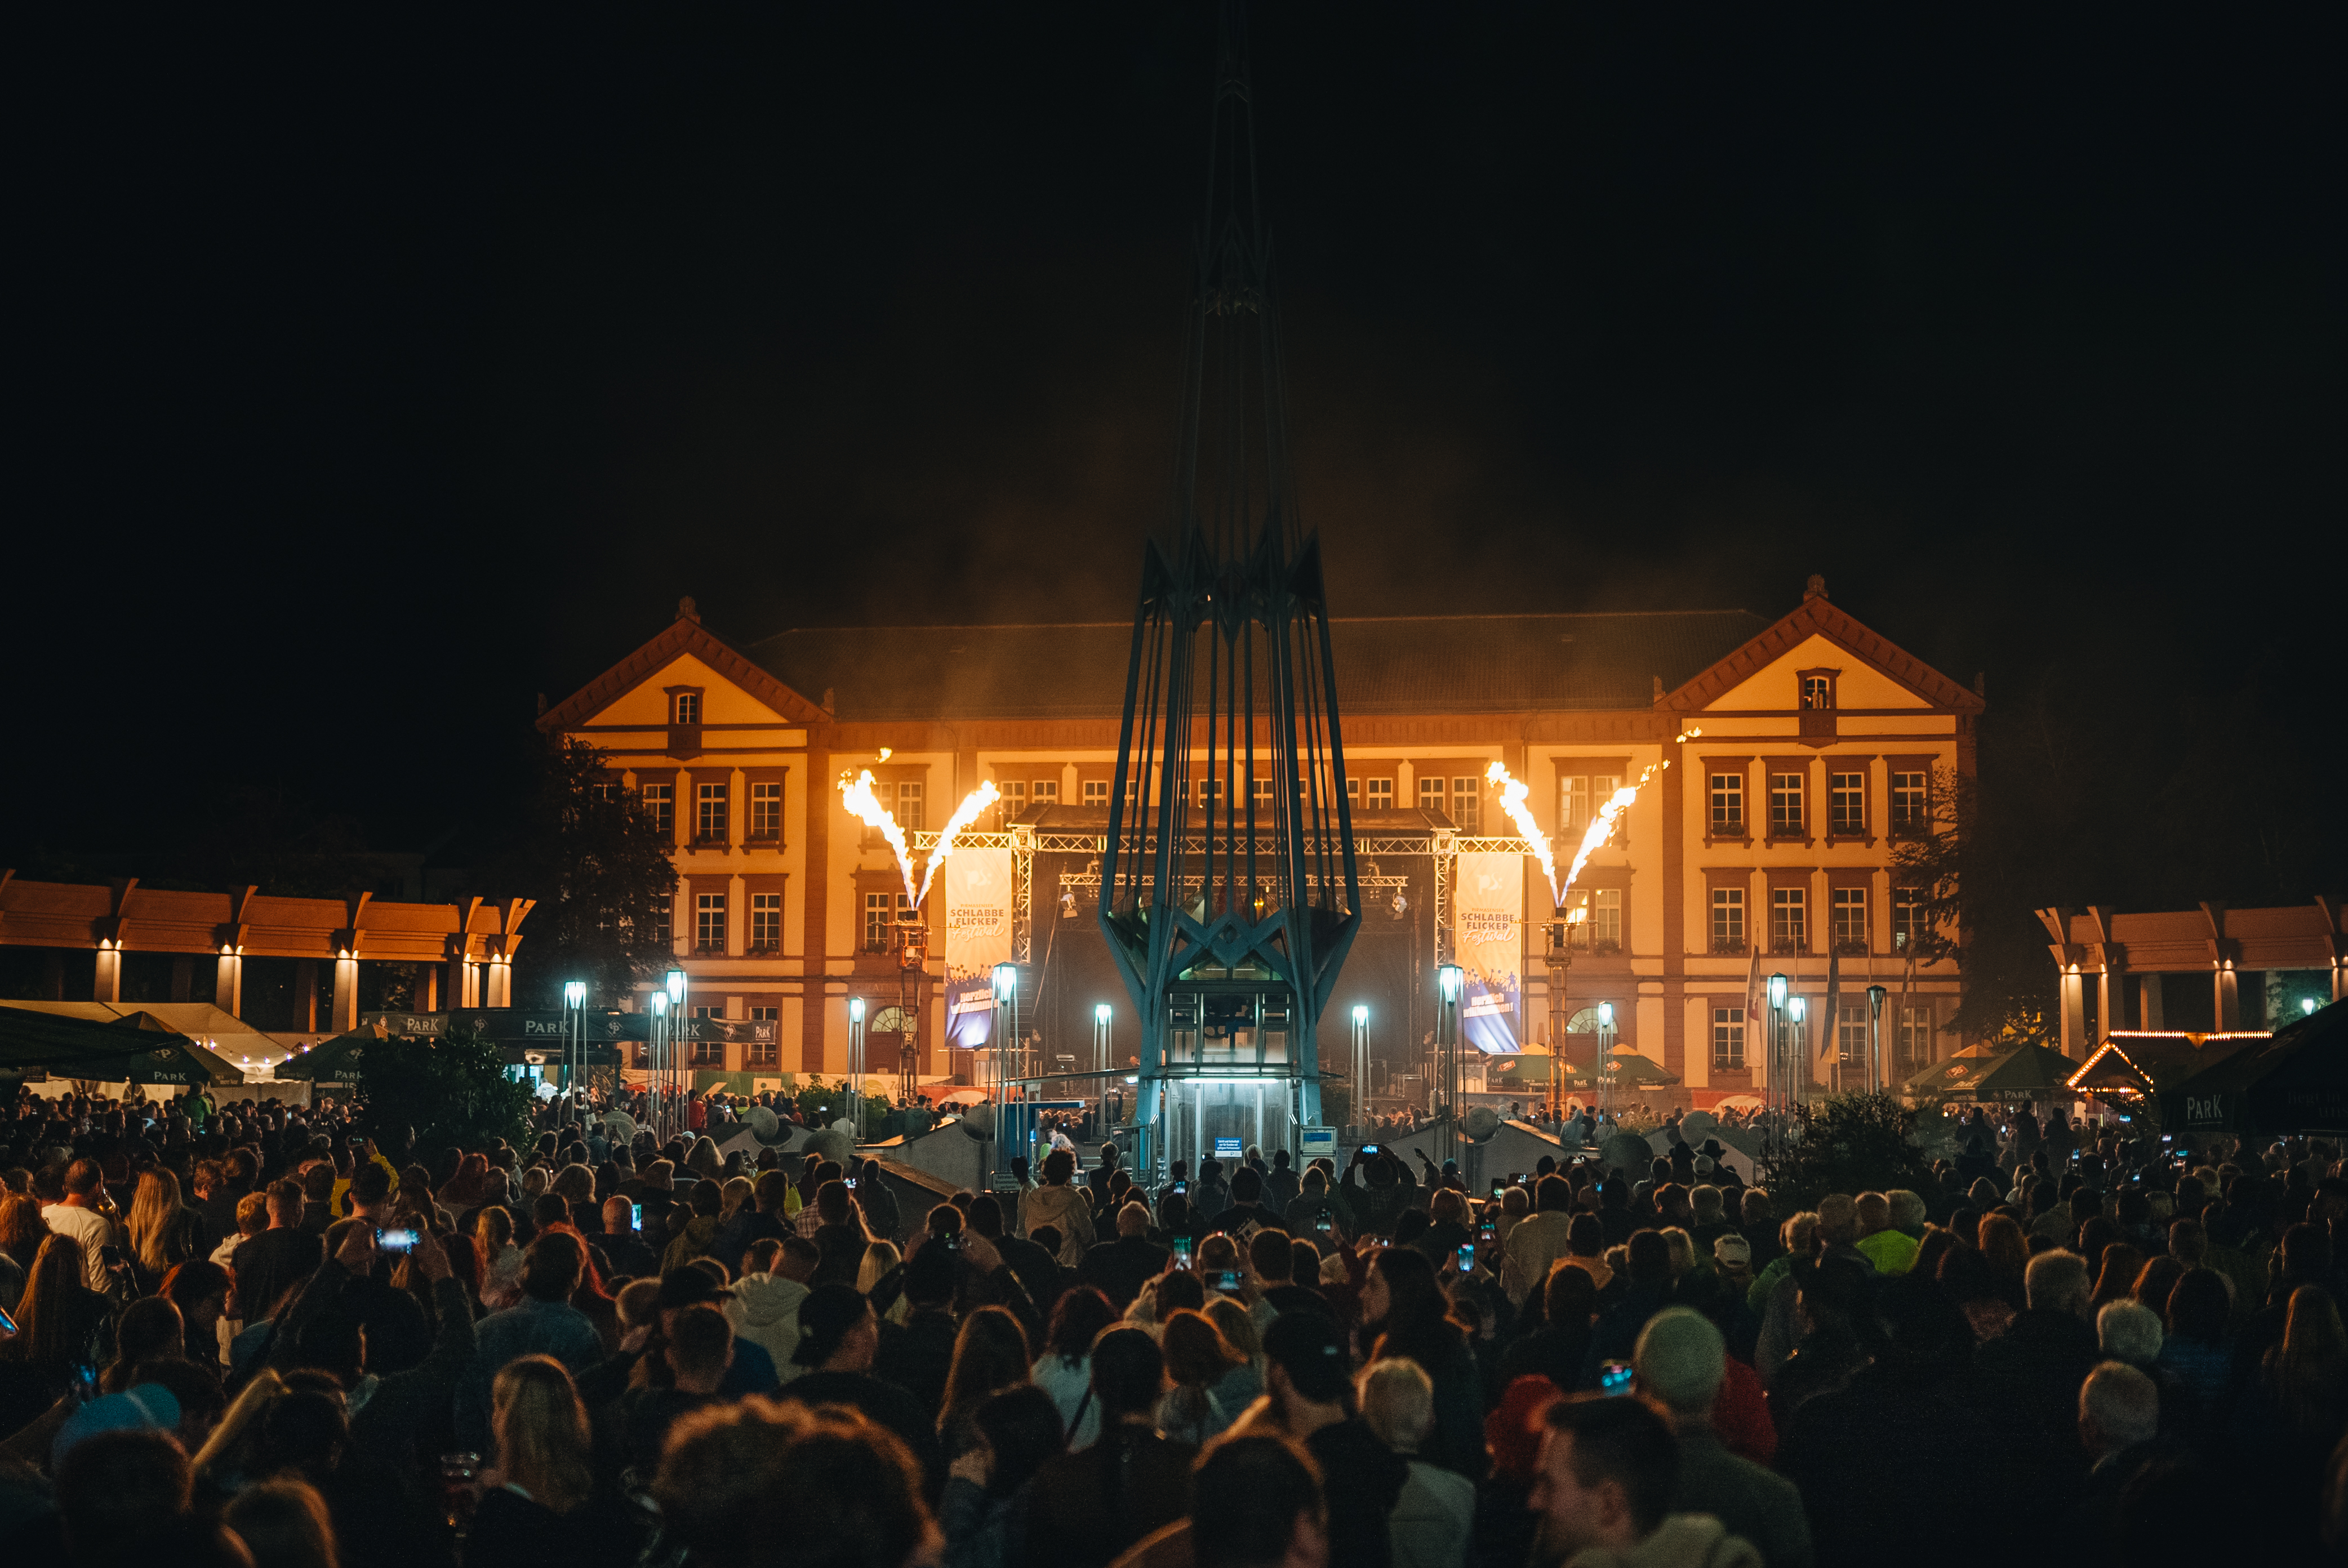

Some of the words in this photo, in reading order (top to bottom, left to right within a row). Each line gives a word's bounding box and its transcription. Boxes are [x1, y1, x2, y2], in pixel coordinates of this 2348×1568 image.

[1461, 913, 1514, 921] SCHLABBE
[951, 922, 1004, 942] Festival
[1462, 927, 1514, 946] Festival
[1471, 992, 1505, 1006] Herzlich
[407, 1017, 440, 1031] PARK
[524, 1020, 570, 1034] PARK
[755, 1026, 771, 1038] PARK
[153, 1071, 187, 1081] PARK
[2004, 1090, 2032, 1098] PARK
[2186, 1094, 2223, 1120] PARK
